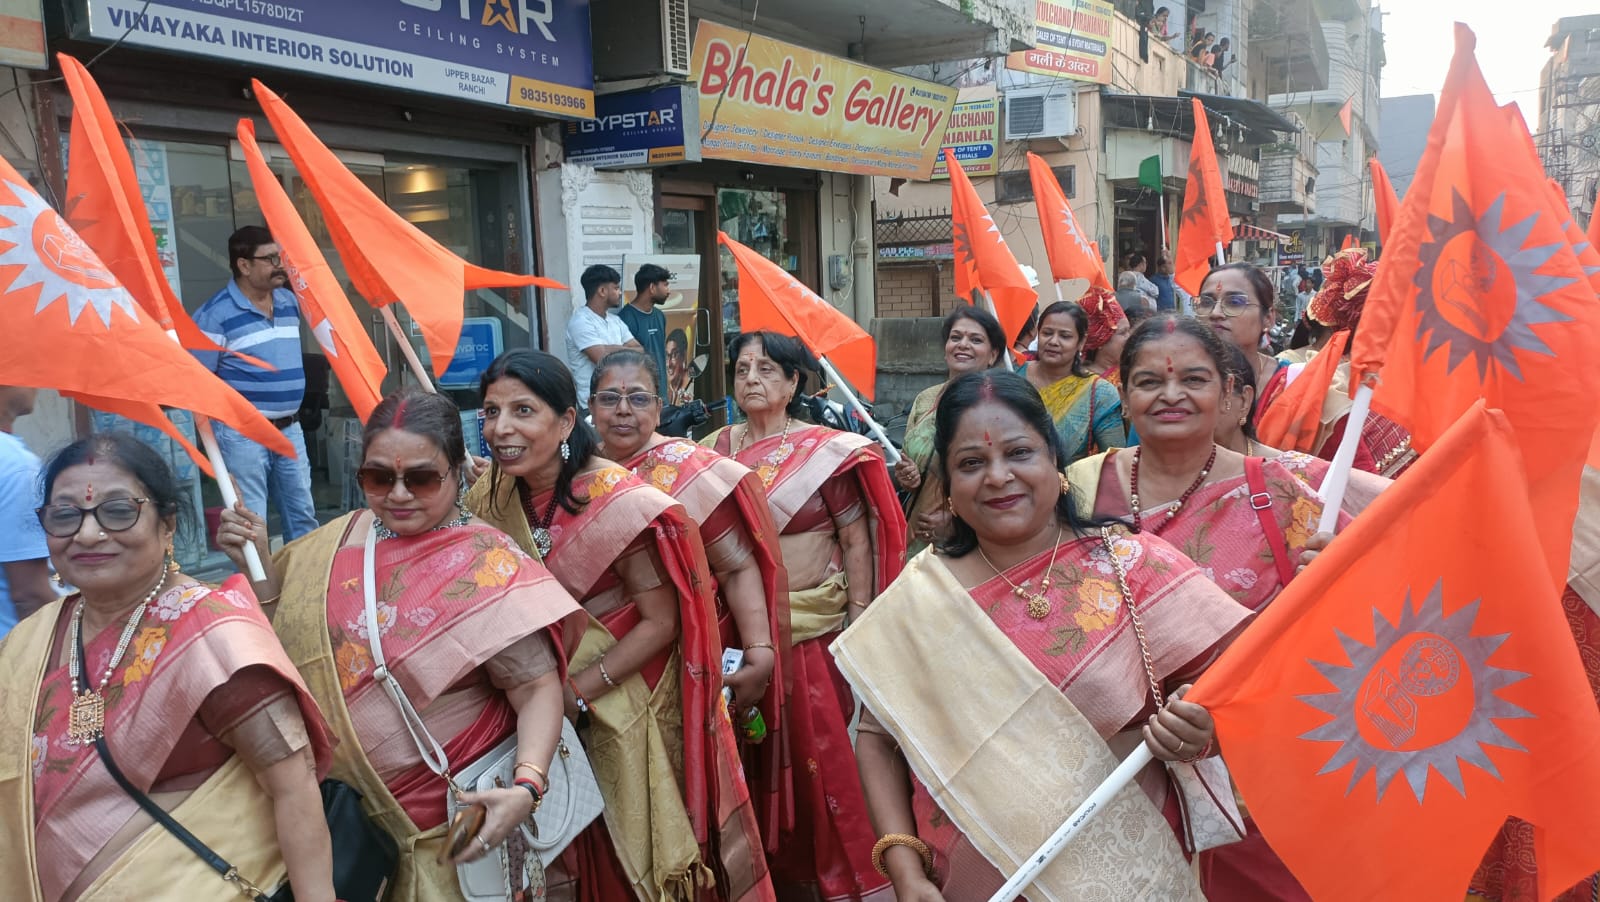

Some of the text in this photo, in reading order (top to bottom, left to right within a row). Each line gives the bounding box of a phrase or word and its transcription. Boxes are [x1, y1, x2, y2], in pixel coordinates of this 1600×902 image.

[402, 0, 557, 42] AR
[107, 7, 414, 78] VINAYAKA INTERIOR SOLUTION
[399, 20, 560, 67] CEILING SYSTEM
[1030, 52, 1053, 67] गली
[1055, 55, 1066, 68] के
[445, 68, 497, 87] UPPER BAZAR,
[458, 82, 486, 95] RANCHI
[520, 87, 586, 110] 9835193966
[700, 42, 943, 146] Bhala's Gallery
[581, 109, 675, 133] GYPSTAR
[948, 111, 995, 128] ULCHAND
[943, 129, 993, 144] NJANLAL
